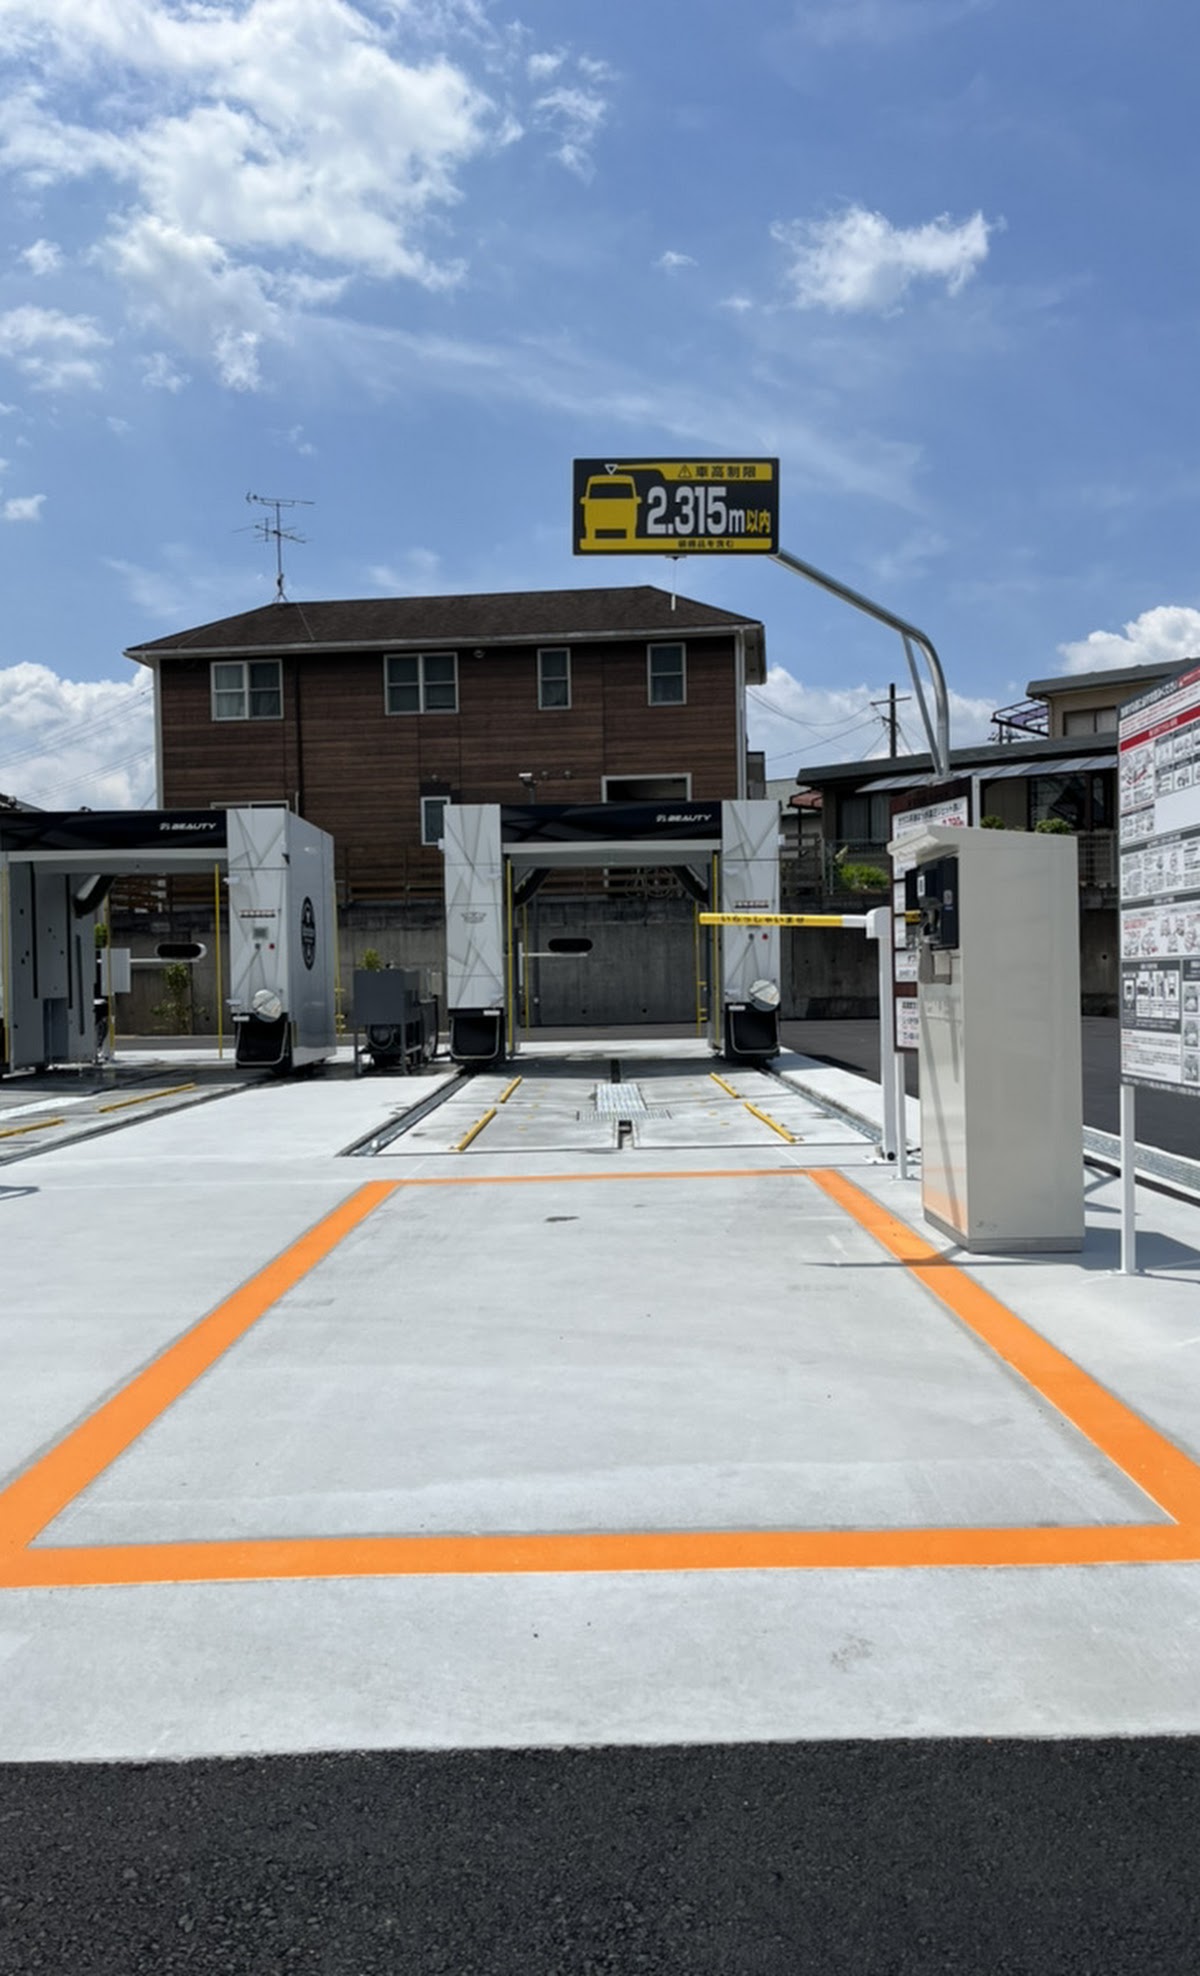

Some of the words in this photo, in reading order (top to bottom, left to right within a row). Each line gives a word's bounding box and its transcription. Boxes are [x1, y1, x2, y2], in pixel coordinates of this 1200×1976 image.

[695, 465, 756, 478] 車高制限
[667, 814, 712, 822] BEAUTY
[171, 822, 217, 831] BEAUTY
[720, 916, 804, 924] いらっしゃいませ
